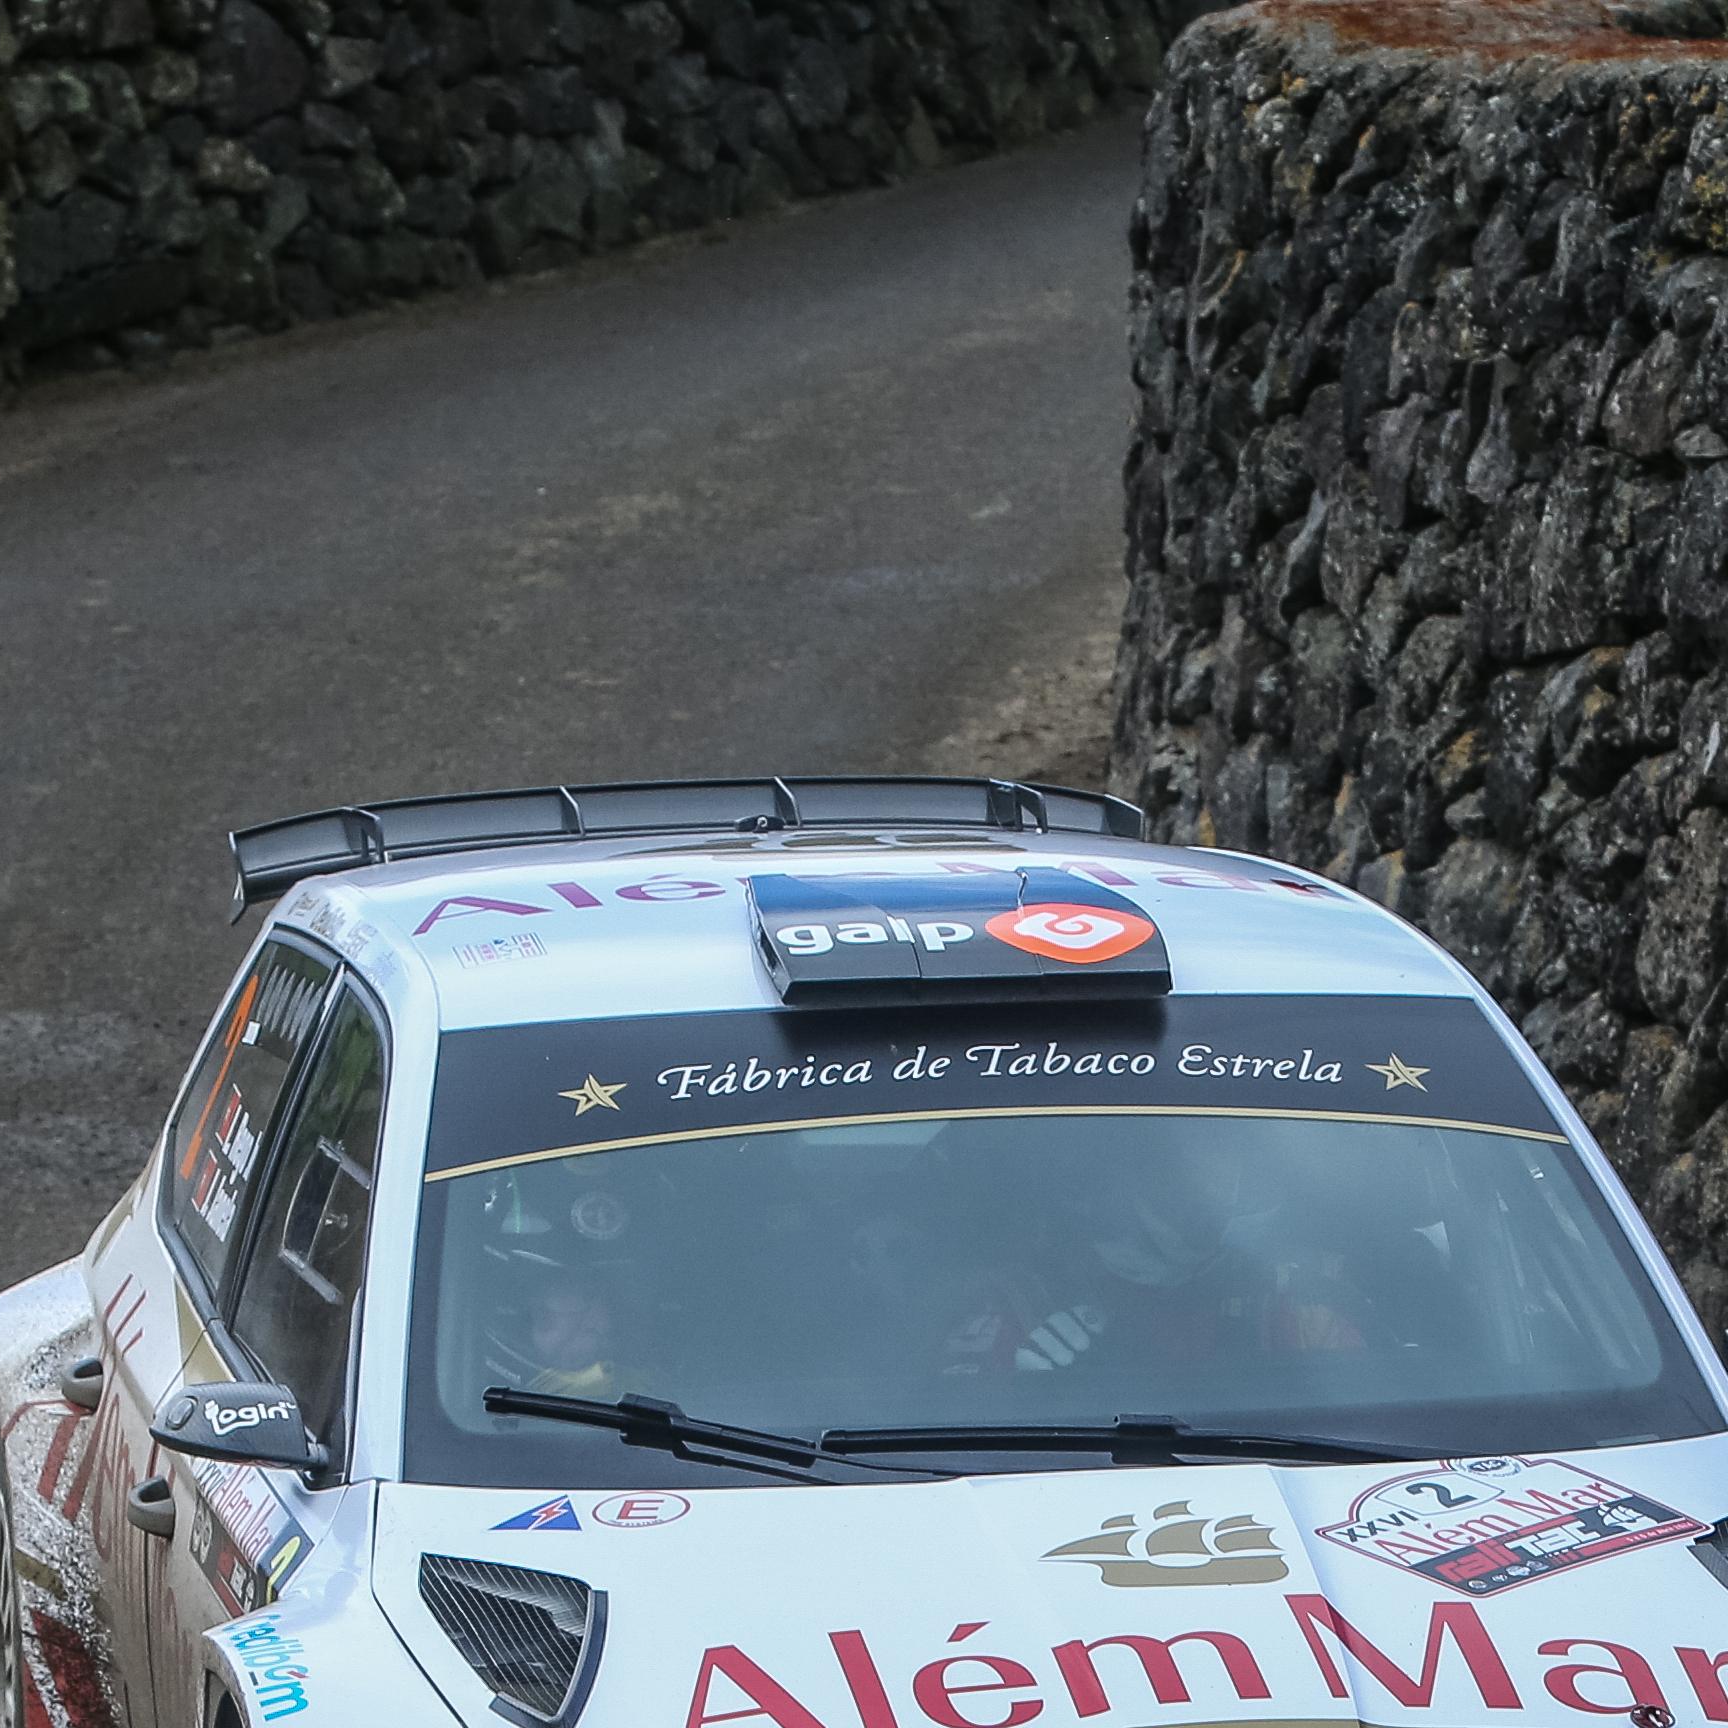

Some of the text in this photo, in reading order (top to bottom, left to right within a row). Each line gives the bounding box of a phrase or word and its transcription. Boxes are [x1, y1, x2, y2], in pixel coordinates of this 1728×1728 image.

[775, 913, 974, 957] galp
[656, 1042, 1344, 1100] Fábrica de Tabaco Estrela
[1405, 1482, 1478, 1508] 2
[1336, 1510, 1419, 1543] XXVI
